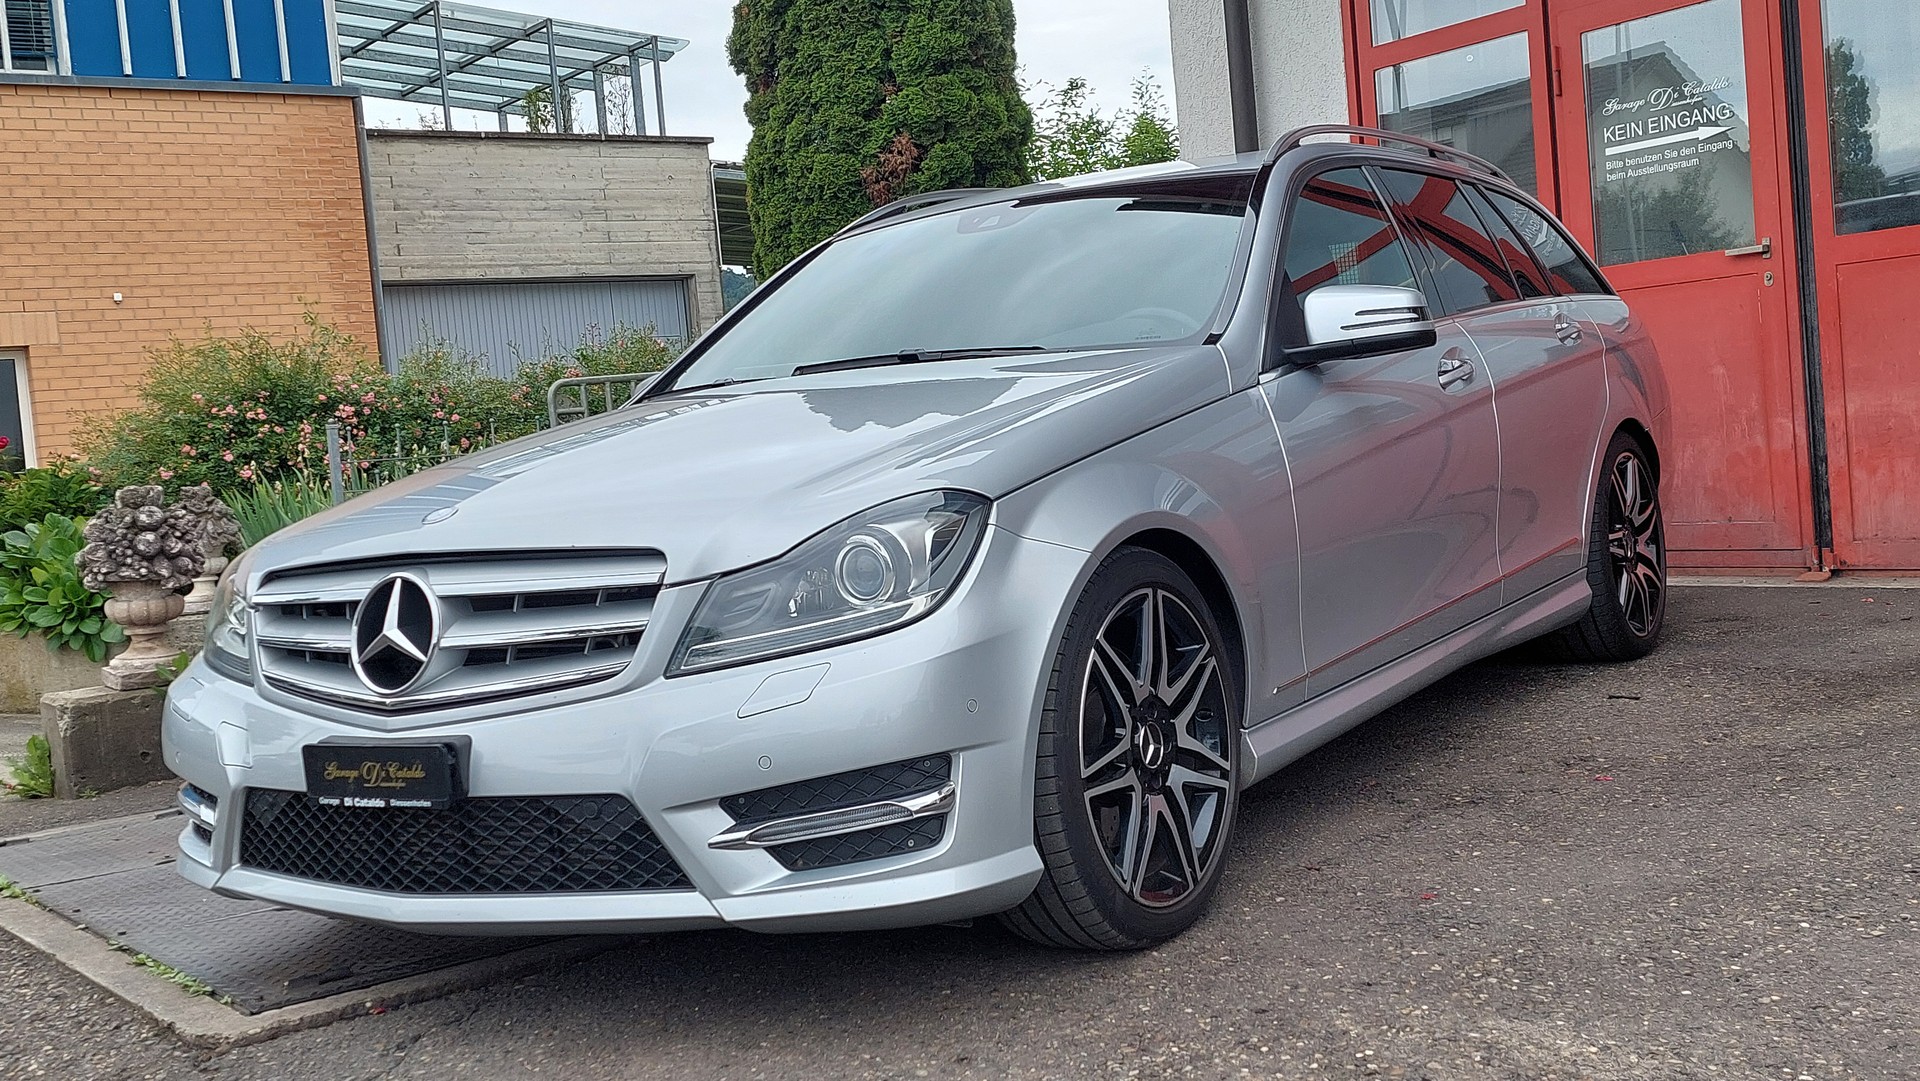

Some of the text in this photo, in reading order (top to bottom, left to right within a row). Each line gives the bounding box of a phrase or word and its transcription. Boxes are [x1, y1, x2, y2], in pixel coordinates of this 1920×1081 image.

[1602, 76, 1730, 116] Garage Di Cataldo
[1603, 103, 1731, 143] KEIN EINGANG
[1605, 139, 1733, 170] Bitte benutzen Sie den Eingang
[1606, 158, 1700, 182] beim Ausstellungsraum
[343, 796, 353, 807] Di
[354, 797, 386, 808] Cataldo
